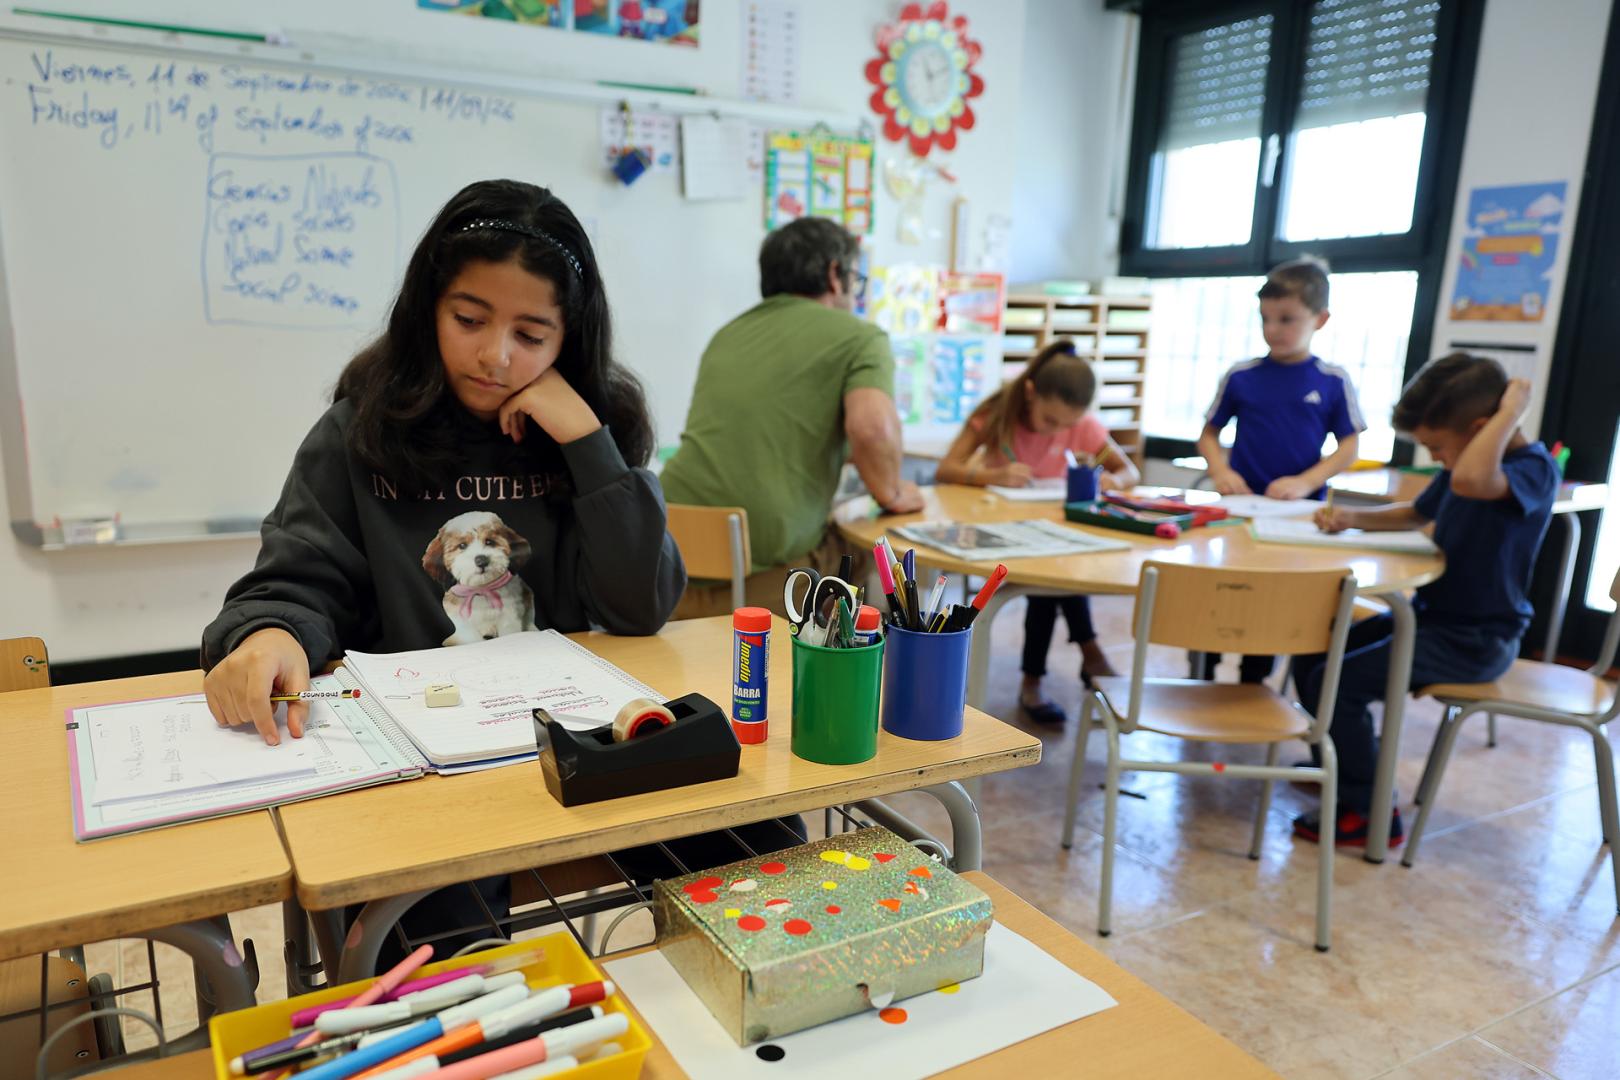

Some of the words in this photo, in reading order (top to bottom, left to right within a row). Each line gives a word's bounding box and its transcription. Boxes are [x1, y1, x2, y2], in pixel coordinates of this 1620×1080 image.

[147, 64, 176, 86] 11
[186, 66, 209, 87] de
[28, 84, 135, 149] Friday,
[372, 473, 397, 500] IN
[455, 476, 524, 500] CUTE
[740, 641, 752, 682] Imedio
[733, 684, 761, 698] BARRA
